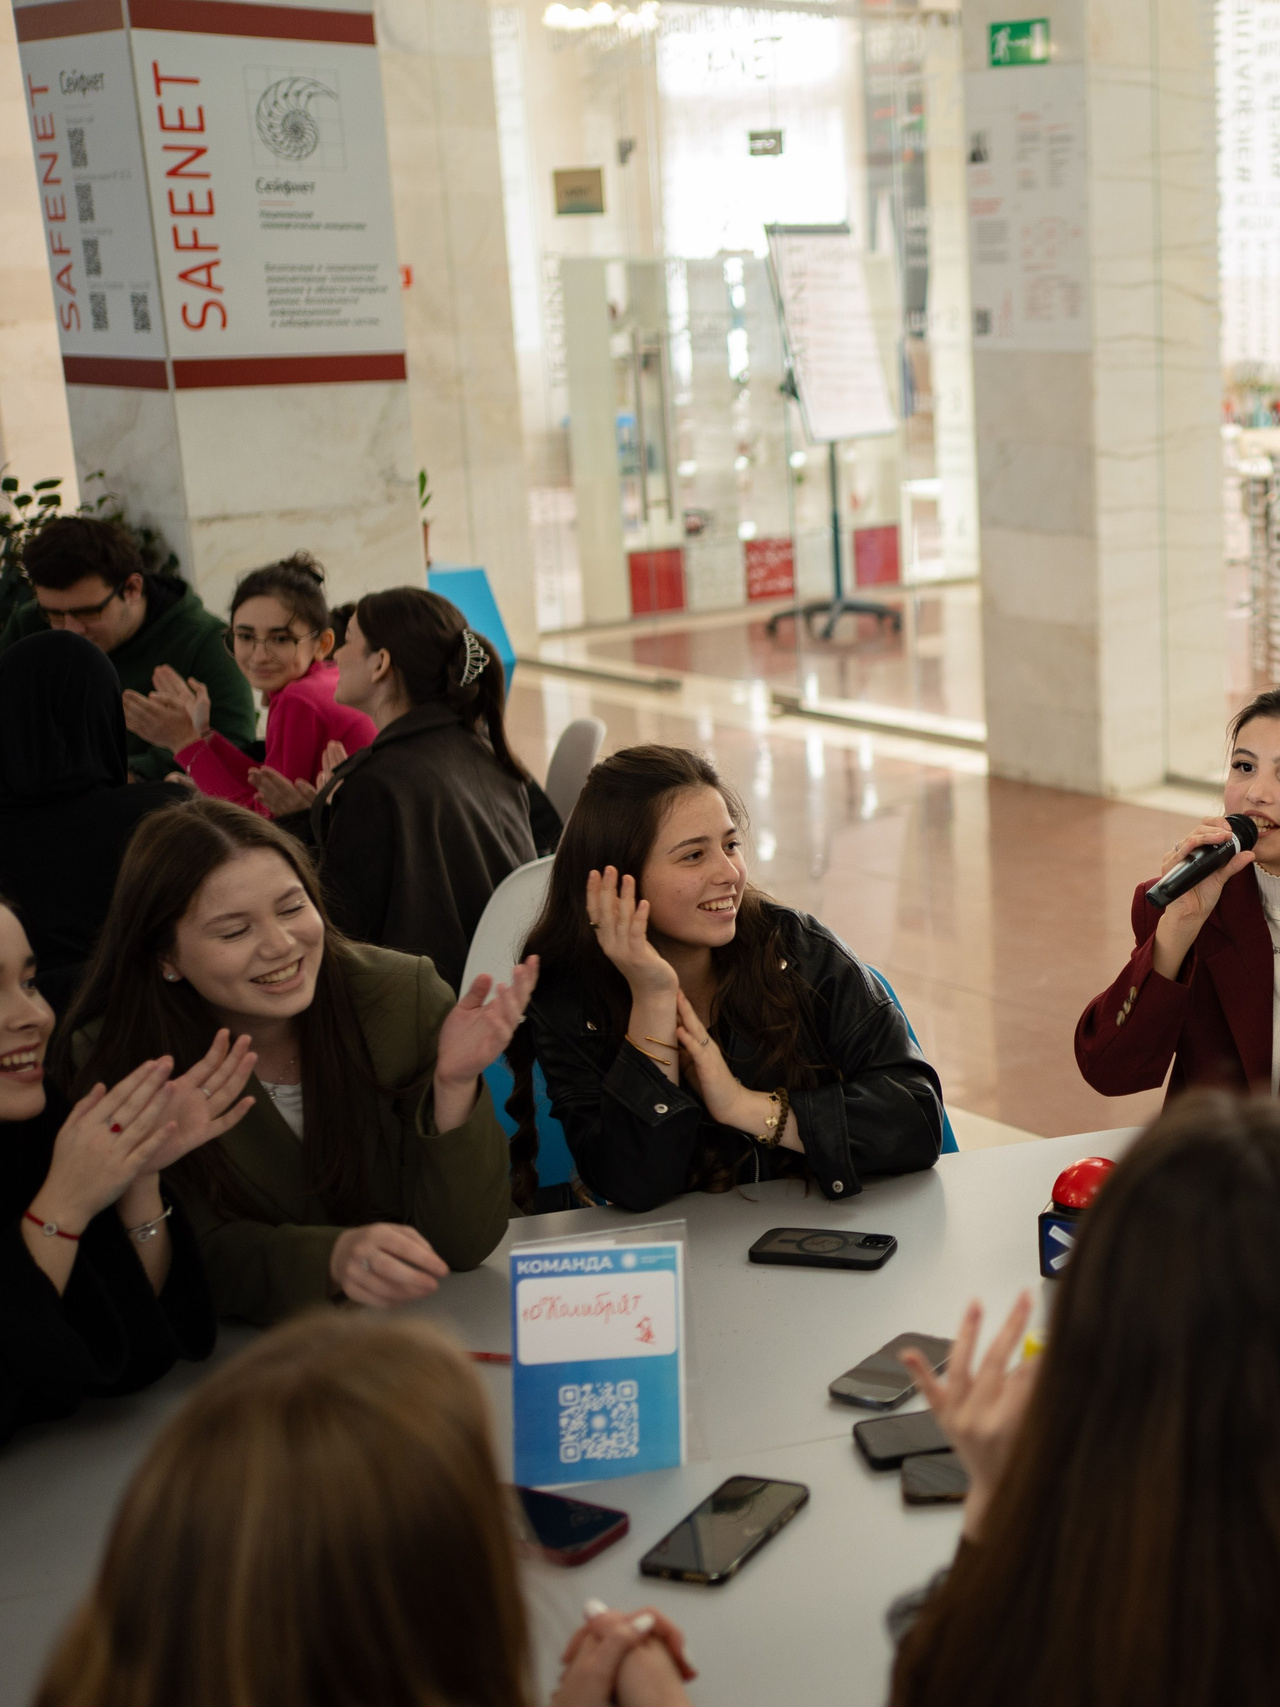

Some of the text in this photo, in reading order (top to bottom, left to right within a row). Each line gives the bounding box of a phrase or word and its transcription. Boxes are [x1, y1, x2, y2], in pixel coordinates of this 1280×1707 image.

[27, 73, 81, 333] SAFENET
[152, 60, 228, 331] SAFENET
[517, 1255, 613, 1275] КОМАНДА
